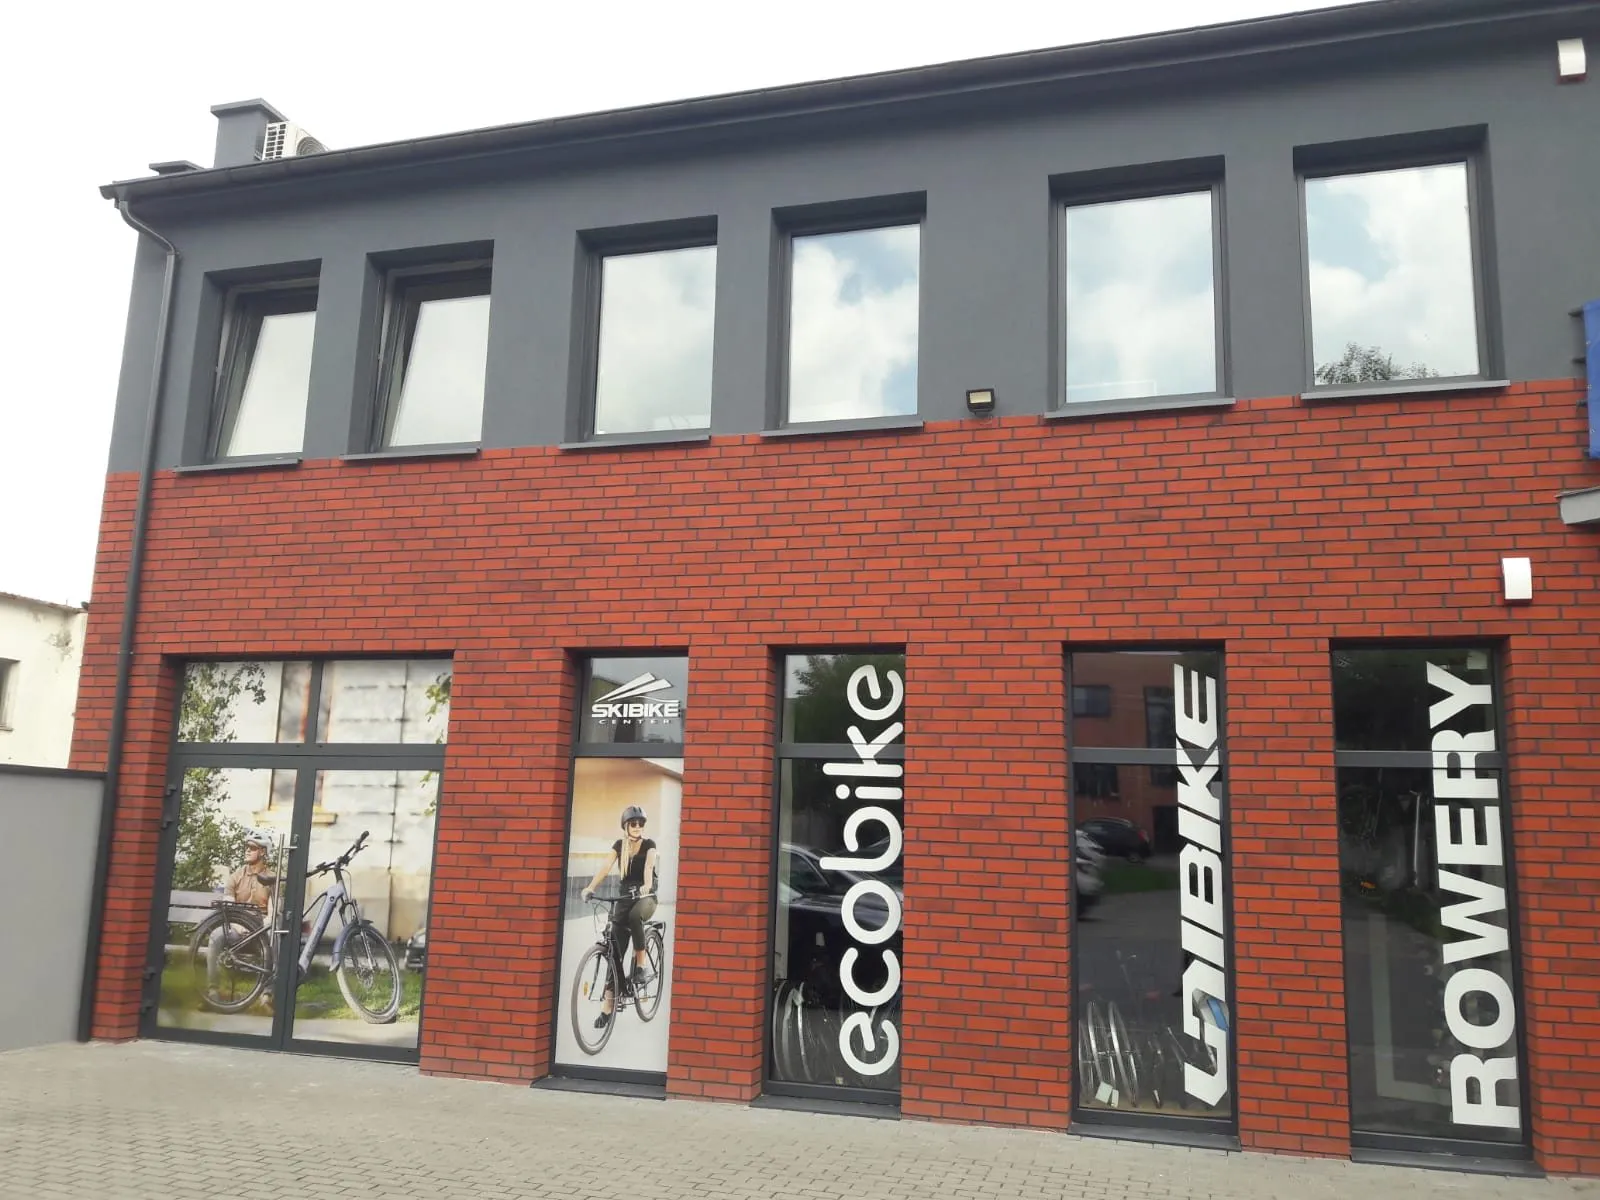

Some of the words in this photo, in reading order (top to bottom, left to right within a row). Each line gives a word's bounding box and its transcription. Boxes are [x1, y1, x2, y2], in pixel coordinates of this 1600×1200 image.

[591, 703, 679, 718] SKIBIKE
[819, 664, 904, 1076] ecobike
[1173, 663, 1229, 1107] UNIBIKE
[1426, 660, 1521, 1129] ROWERY
